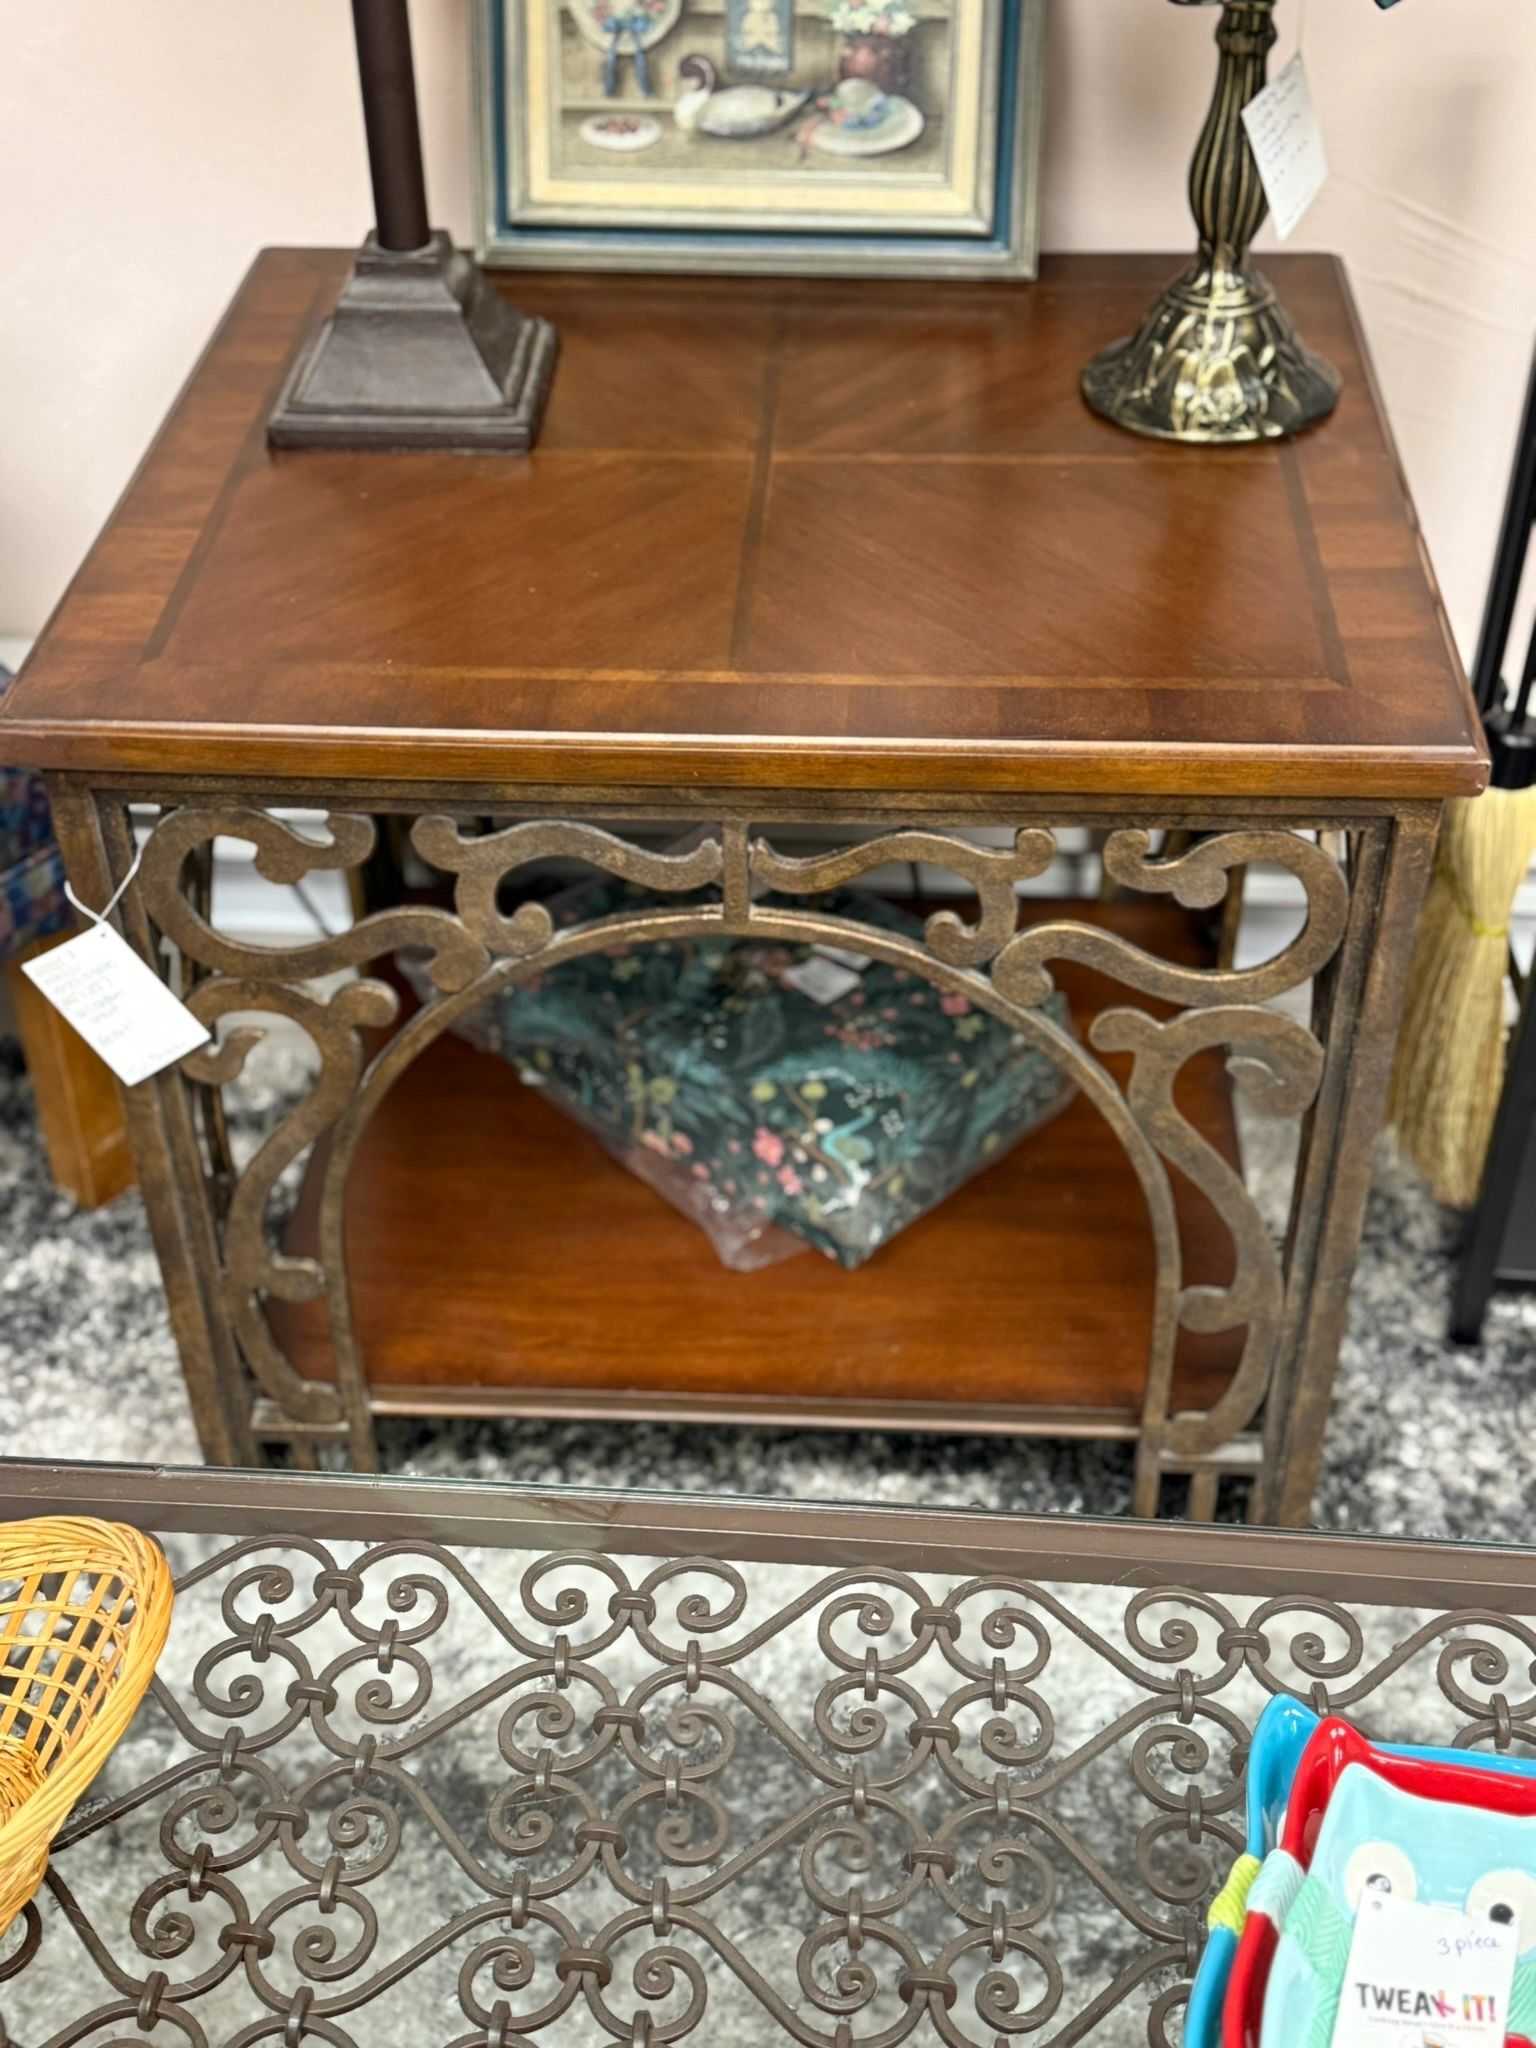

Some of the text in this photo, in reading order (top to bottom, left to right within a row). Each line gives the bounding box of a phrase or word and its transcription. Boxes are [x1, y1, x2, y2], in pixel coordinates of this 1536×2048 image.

[1437, 1938, 1450, 1956] 3
[1355, 1983, 1496, 2022] TWEAK IT!
